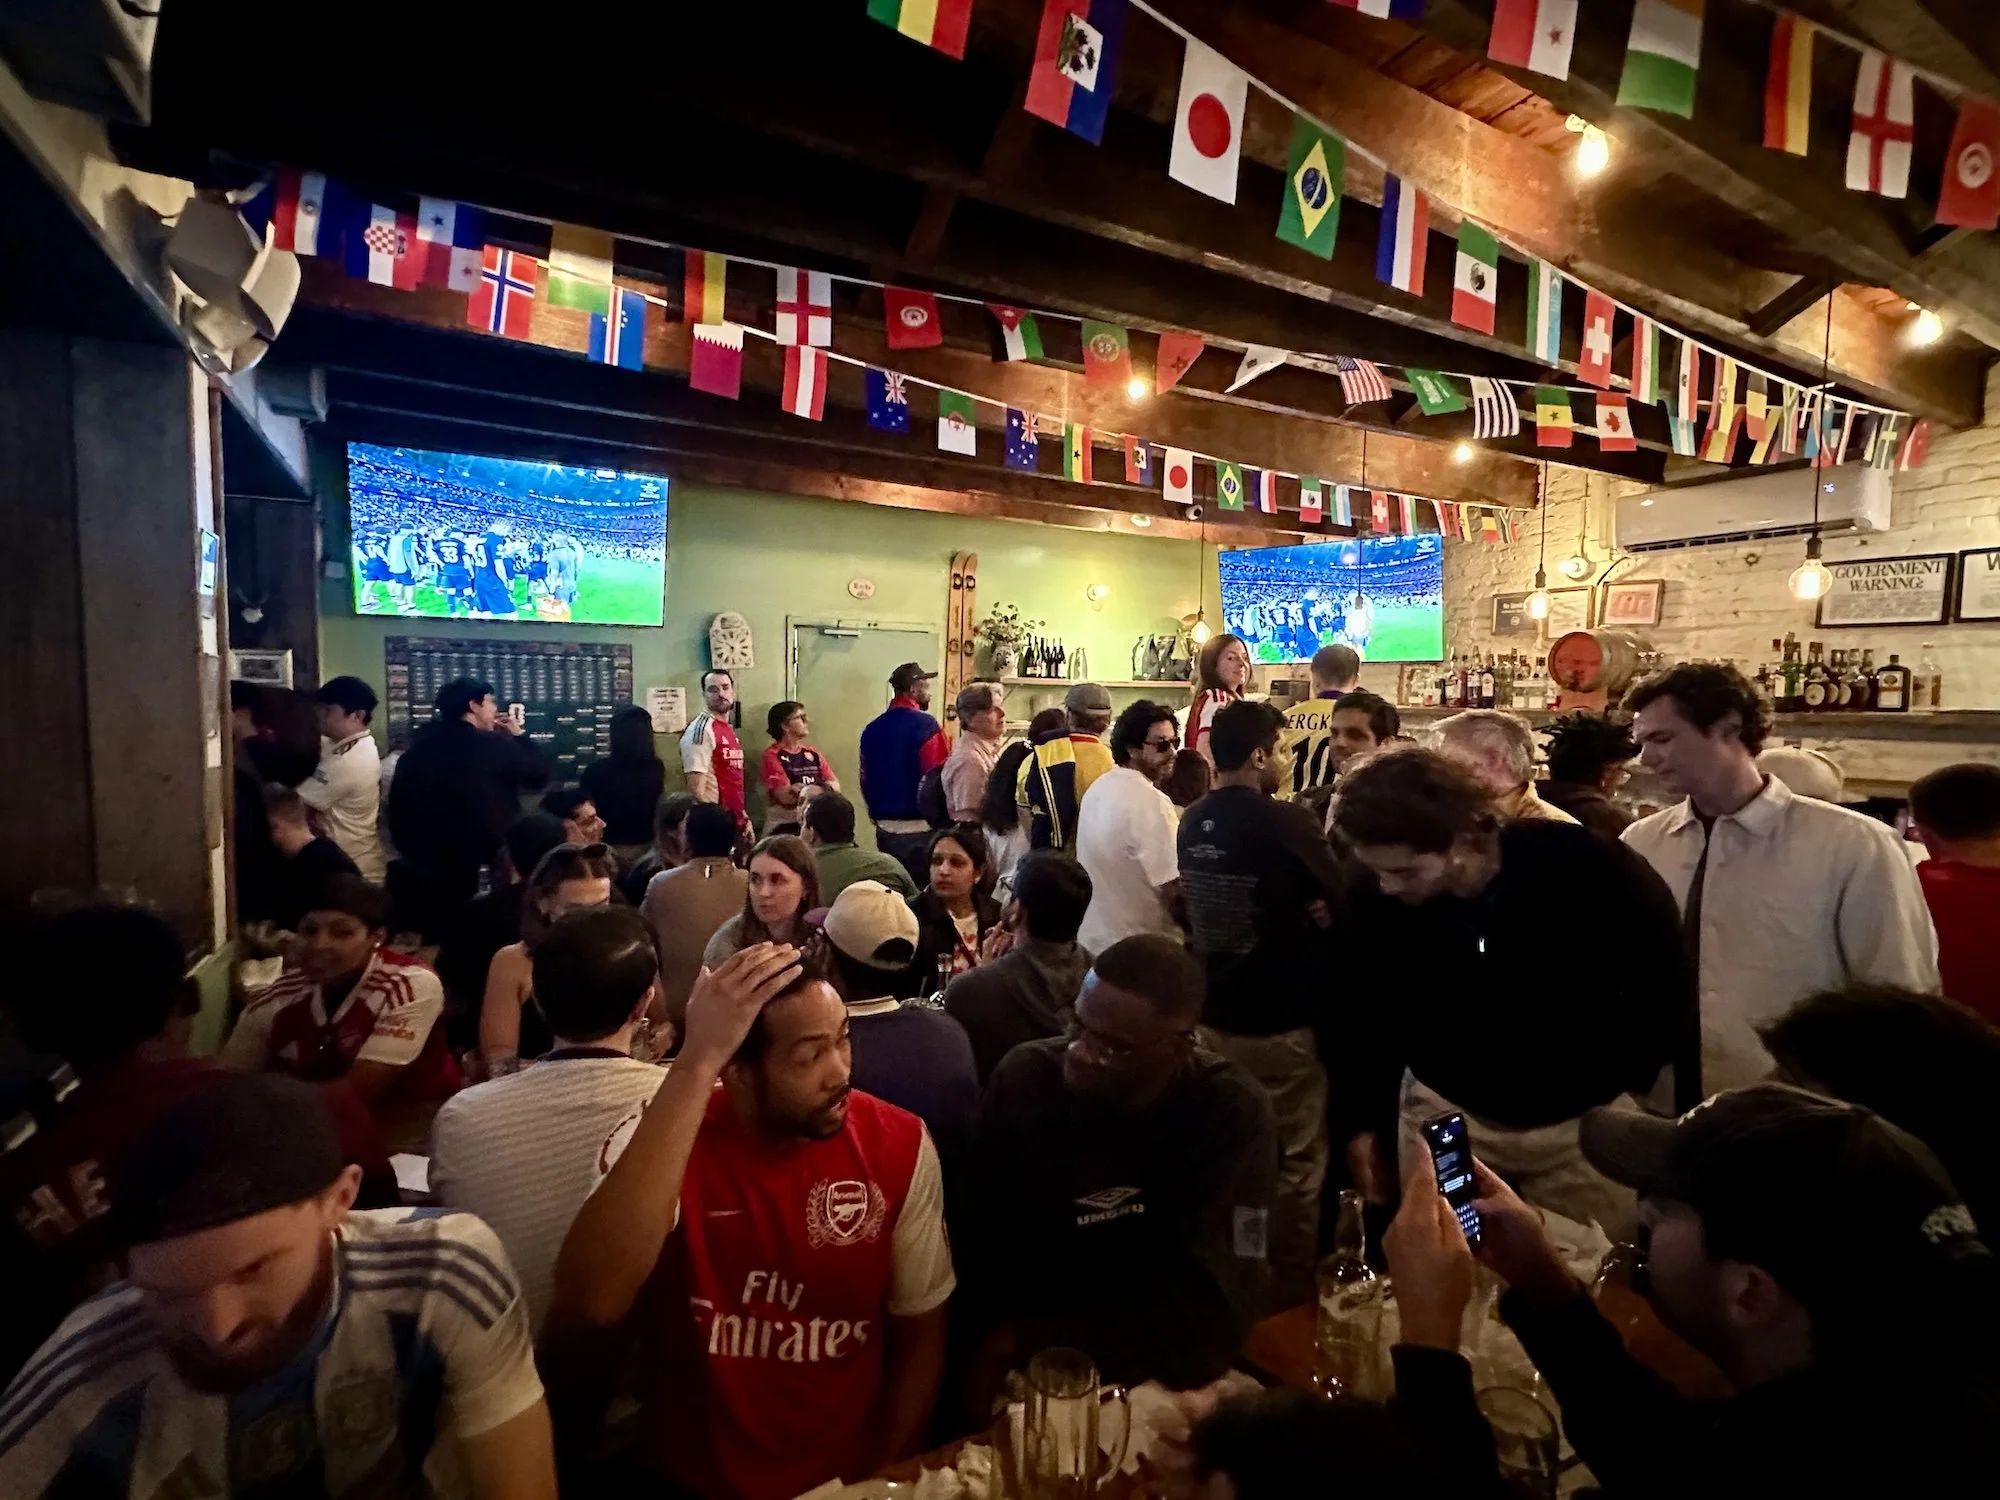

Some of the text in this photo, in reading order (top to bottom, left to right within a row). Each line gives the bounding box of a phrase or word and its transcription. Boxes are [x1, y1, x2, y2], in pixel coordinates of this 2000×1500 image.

[1834, 560, 1945, 579] GOVERNMENT
[1850, 577, 1925, 592] WARNING:
[1287, 713, 1331, 730] ERGK
[742, 1270, 804, 1311] Fly
